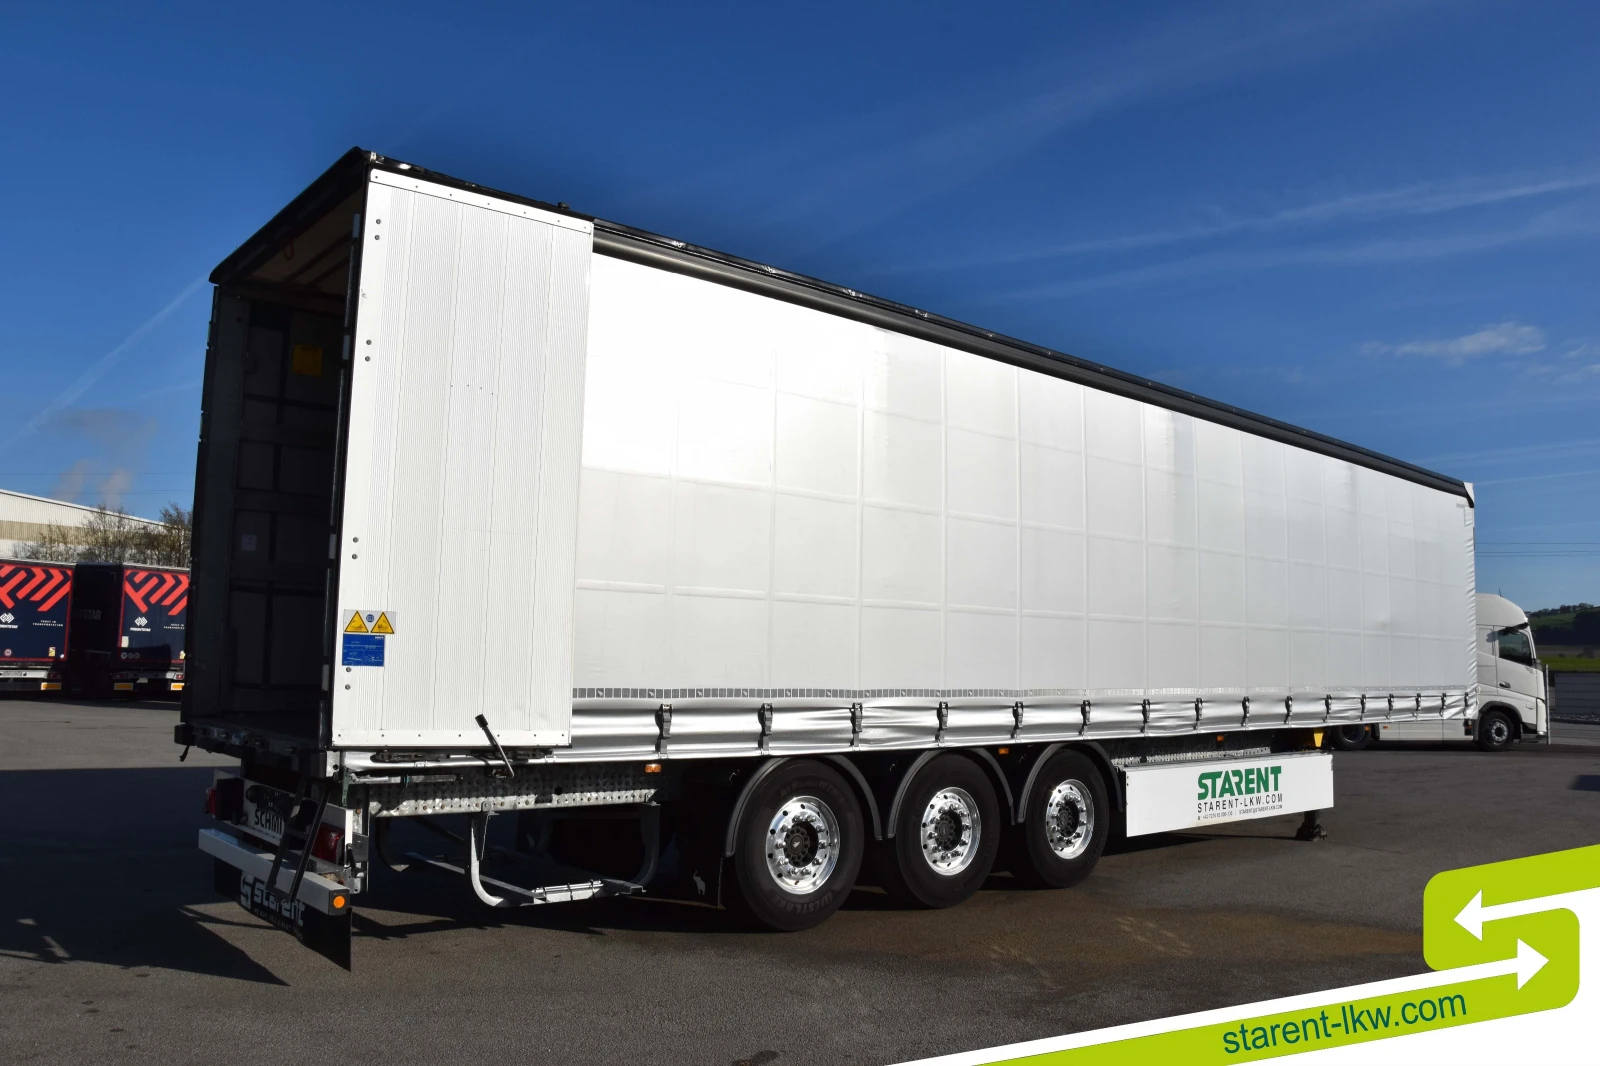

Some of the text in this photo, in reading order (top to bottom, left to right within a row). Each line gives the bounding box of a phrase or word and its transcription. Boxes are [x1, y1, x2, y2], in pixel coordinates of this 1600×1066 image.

[1198, 766, 1282, 801] STARENT
[1198, 793, 1283, 813] STARENT-LKW.COM
[254, 808, 286, 835] SCHMI
